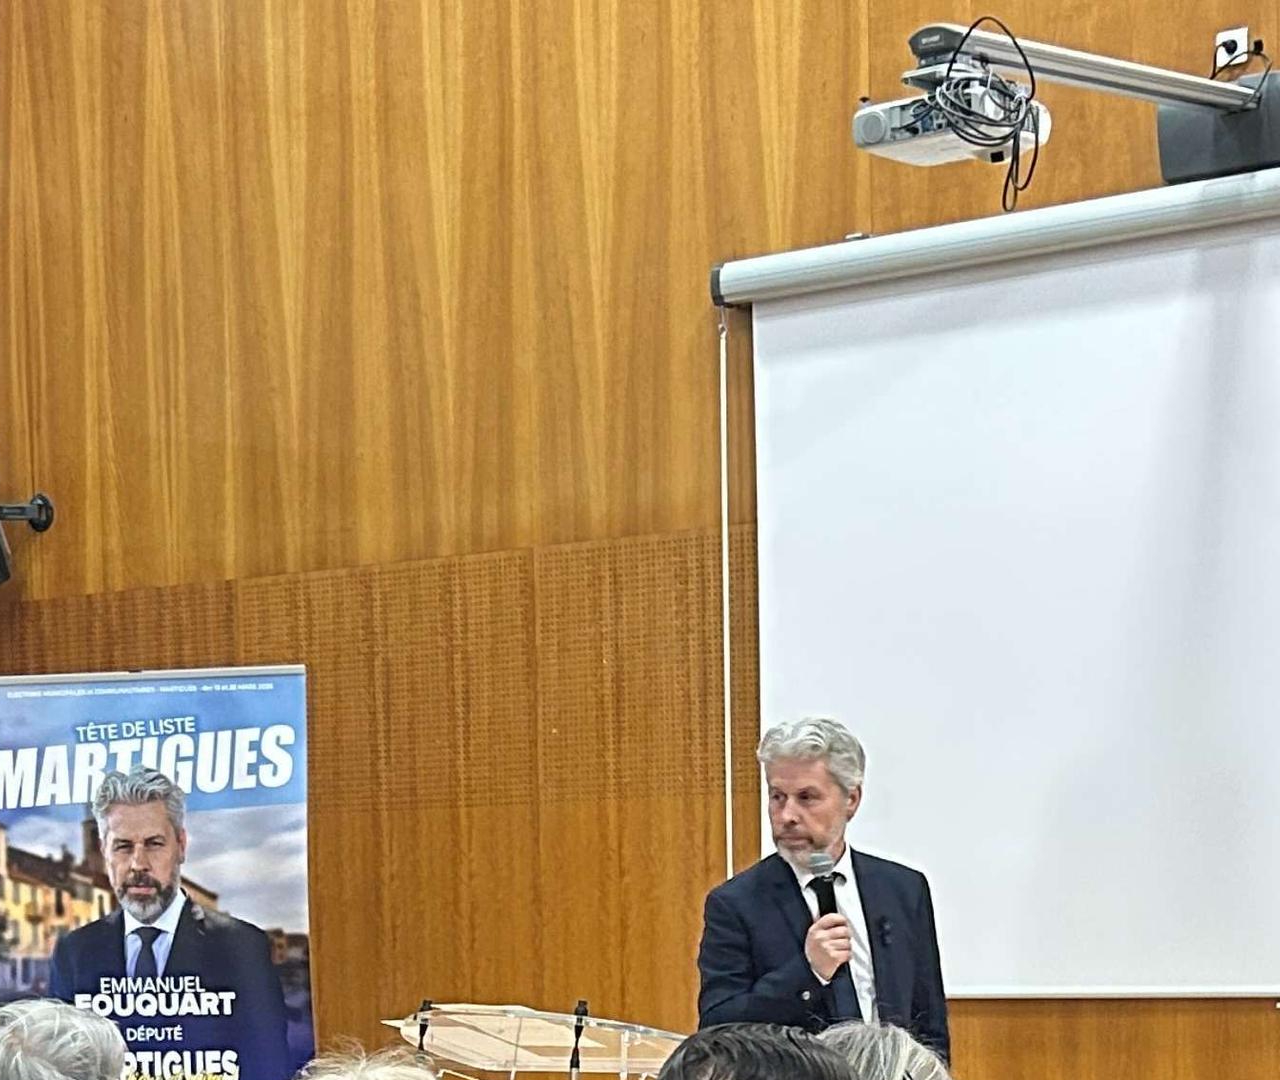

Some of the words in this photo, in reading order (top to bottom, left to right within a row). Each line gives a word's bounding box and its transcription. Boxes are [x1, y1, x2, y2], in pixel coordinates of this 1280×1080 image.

[76, 722, 119, 742] TÊTE
[122, 720, 146, 738] DE
[149, 716, 196, 735] LISTE
[100, 975, 205, 994] EMMANUEL
[74, 991, 236, 1018] FOUQUART
[126, 1024, 183, 1042] DÉPUTÉ
